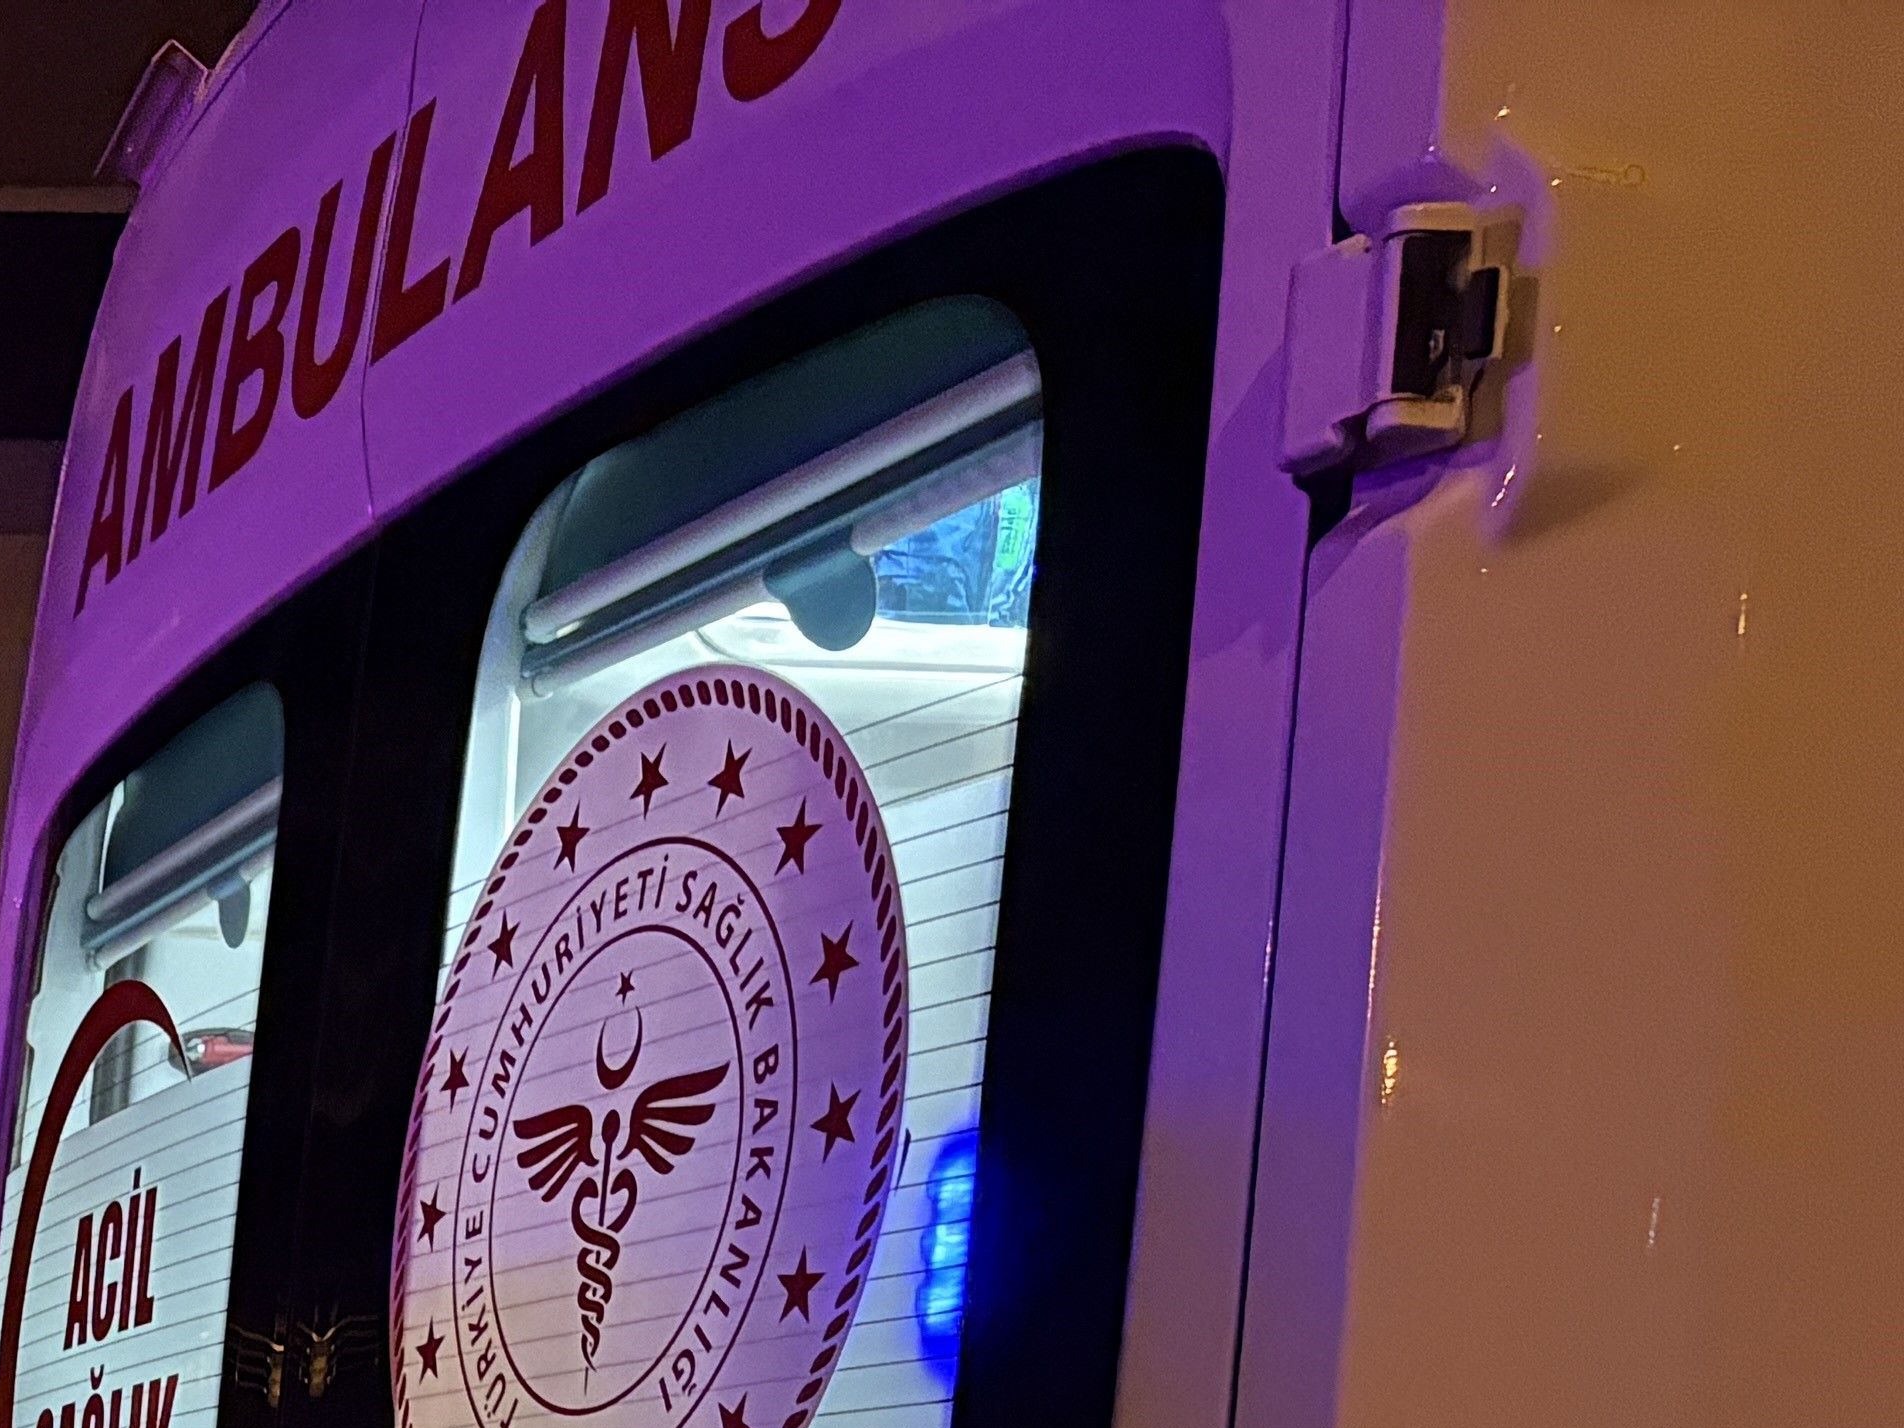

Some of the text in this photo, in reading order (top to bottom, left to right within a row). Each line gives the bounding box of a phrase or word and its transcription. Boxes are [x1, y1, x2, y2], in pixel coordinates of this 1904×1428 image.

[472, 853, 670, 1183] CUMHURİYETİ
[675, 869, 774, 1031] SAĞLIK
[63, 1165, 158, 1351] ACİL
[659, 1043, 779, 1412] BAKANLIĞI
